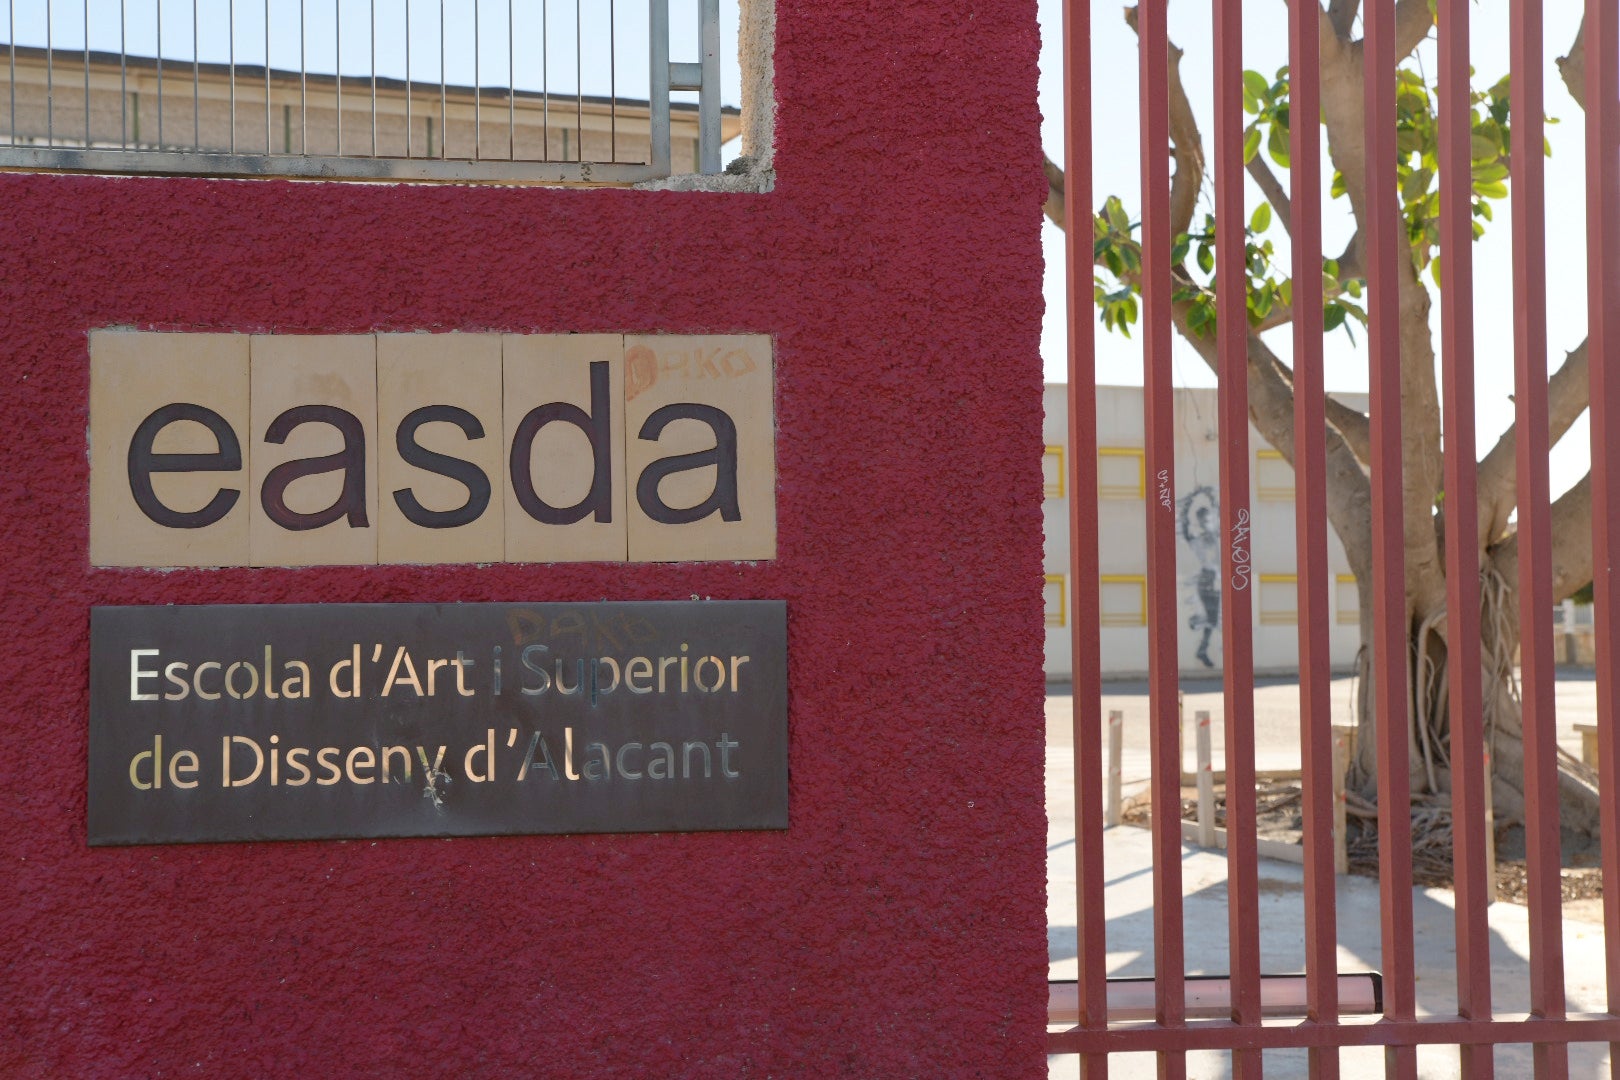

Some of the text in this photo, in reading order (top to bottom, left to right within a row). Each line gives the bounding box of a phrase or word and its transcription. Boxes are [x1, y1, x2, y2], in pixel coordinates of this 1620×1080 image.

[127, 361, 742, 531] easda
[130, 642, 750, 707] Escola d’Art i Superior
[129, 727, 740, 807] de Disseny d’Alacant
